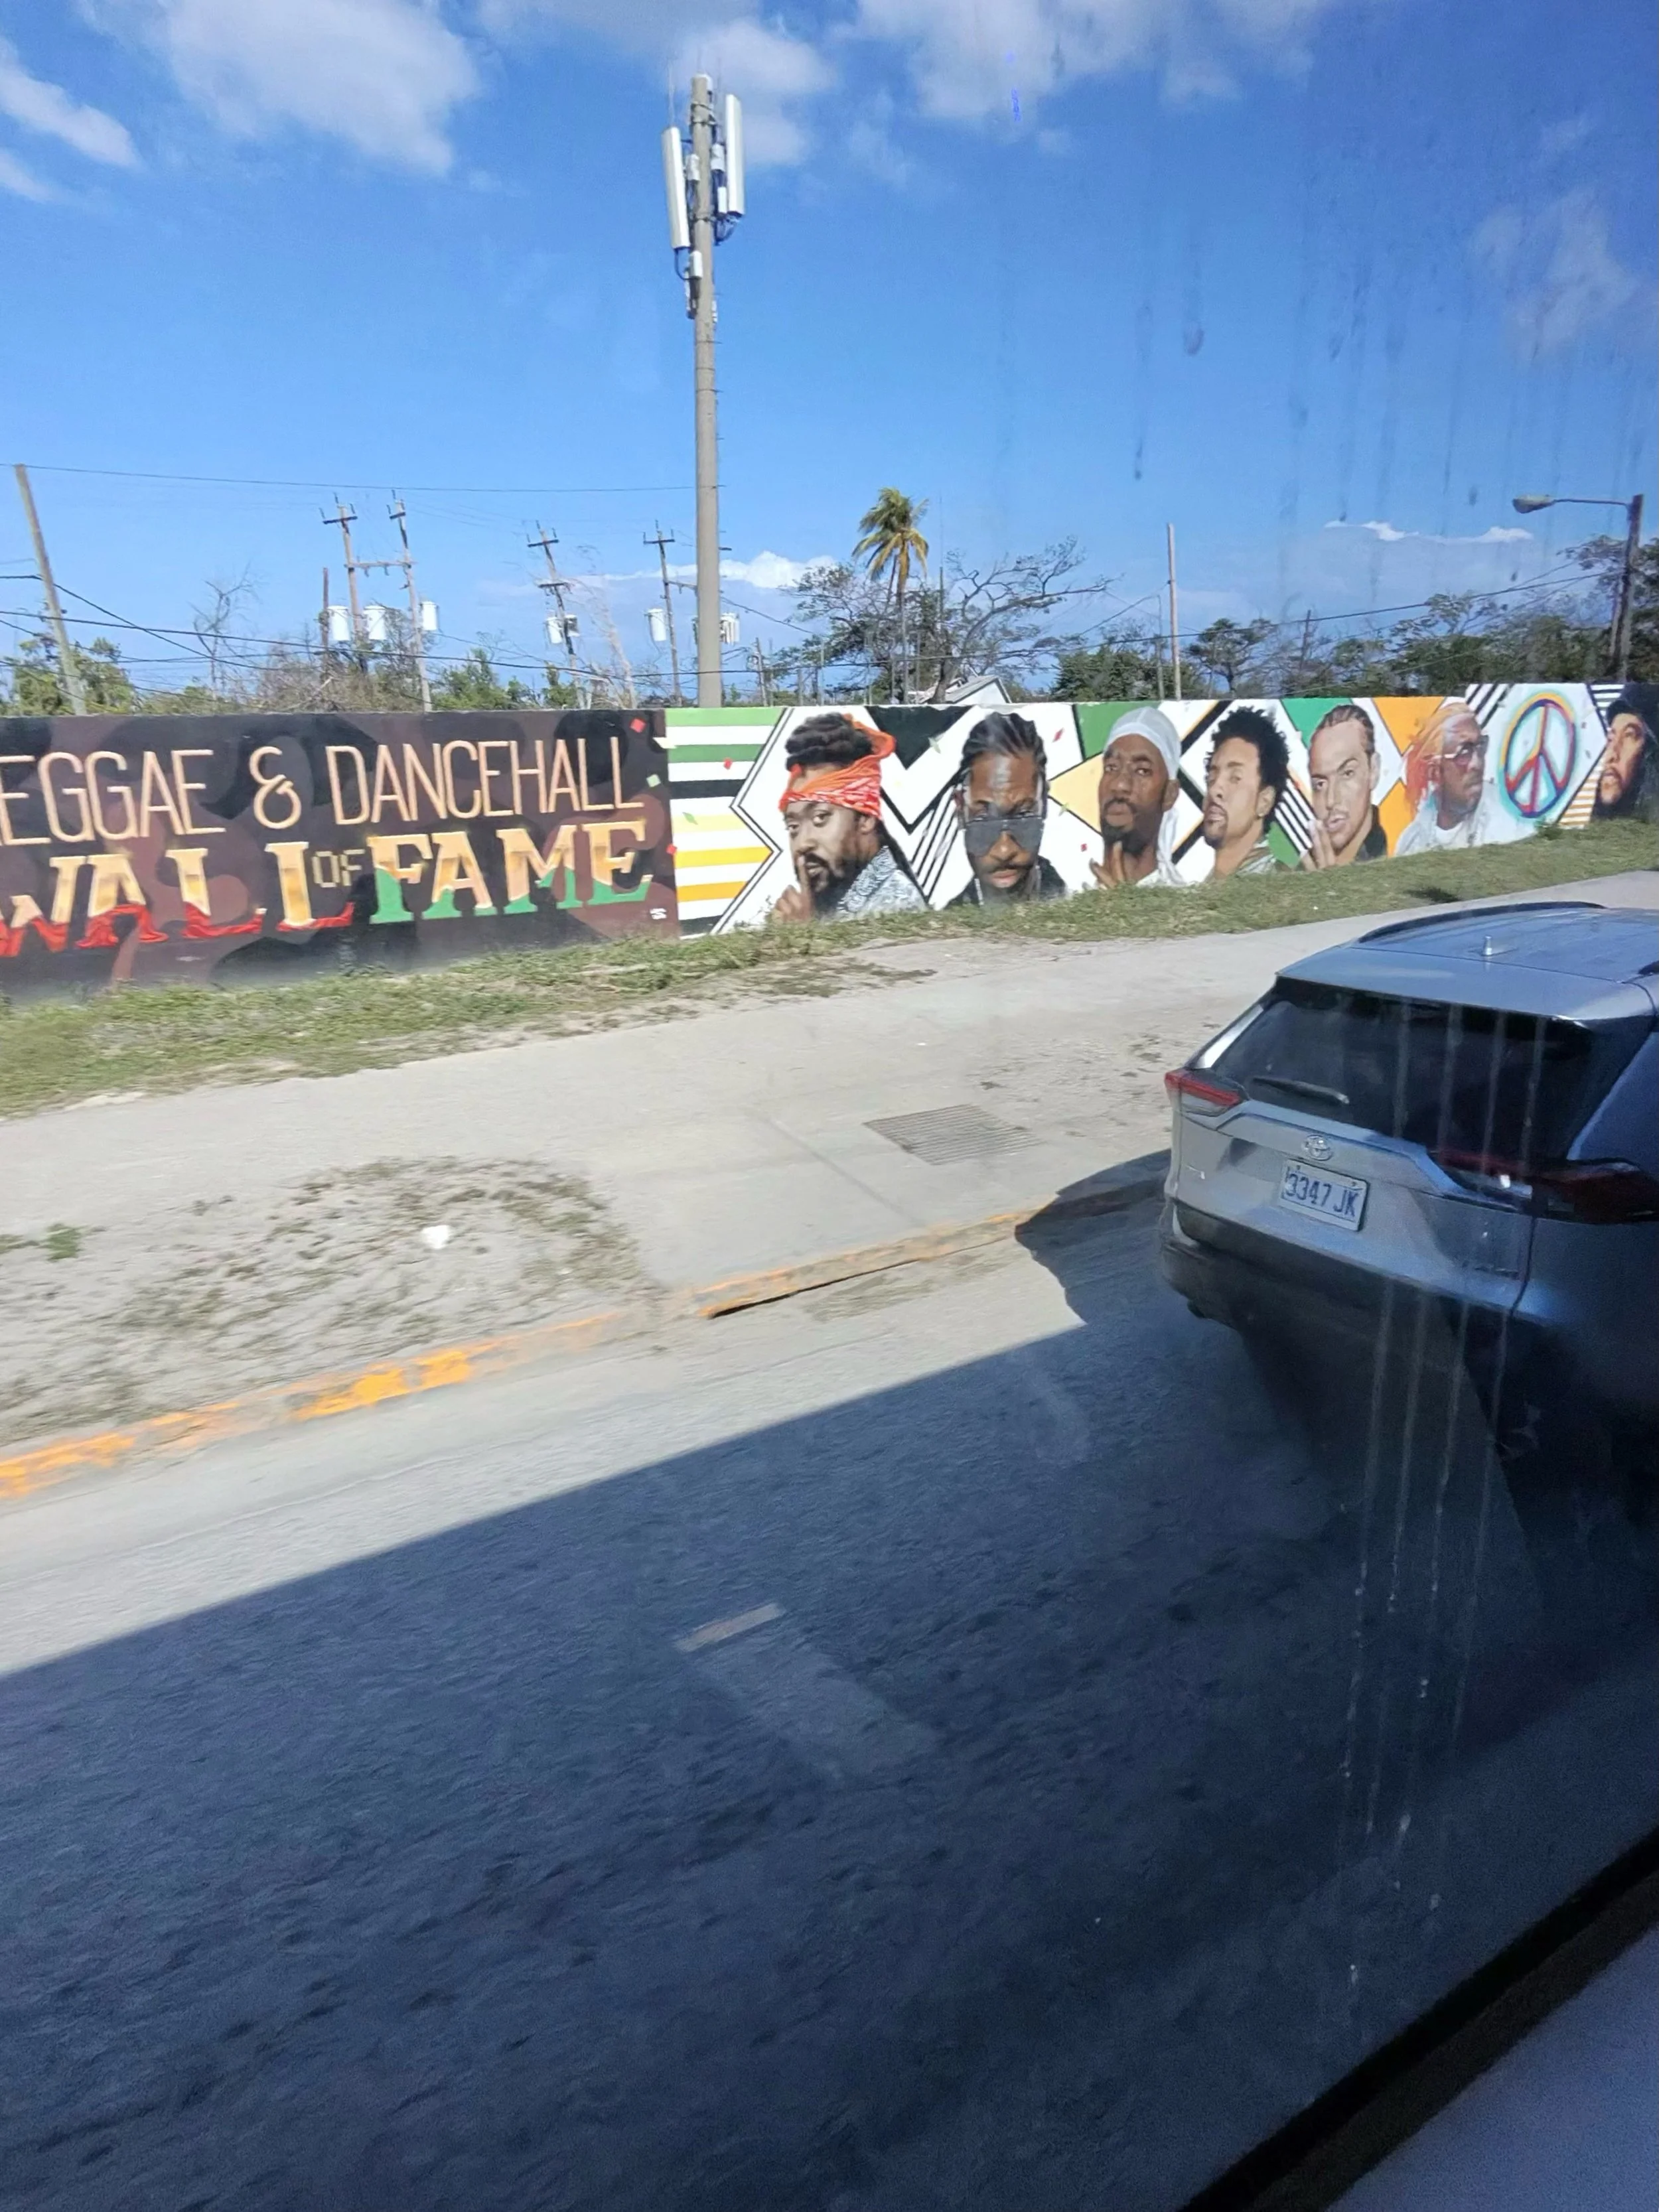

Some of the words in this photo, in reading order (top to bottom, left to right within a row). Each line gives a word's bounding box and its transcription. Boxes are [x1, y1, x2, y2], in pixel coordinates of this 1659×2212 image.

[250, 746, 302, 829] &
[326, 736, 644, 824] DANCEHALL
[313, 849, 365, 887] OF
[368, 820, 653, 924] FAME
[1333, 1190, 1358, 1217] JK
